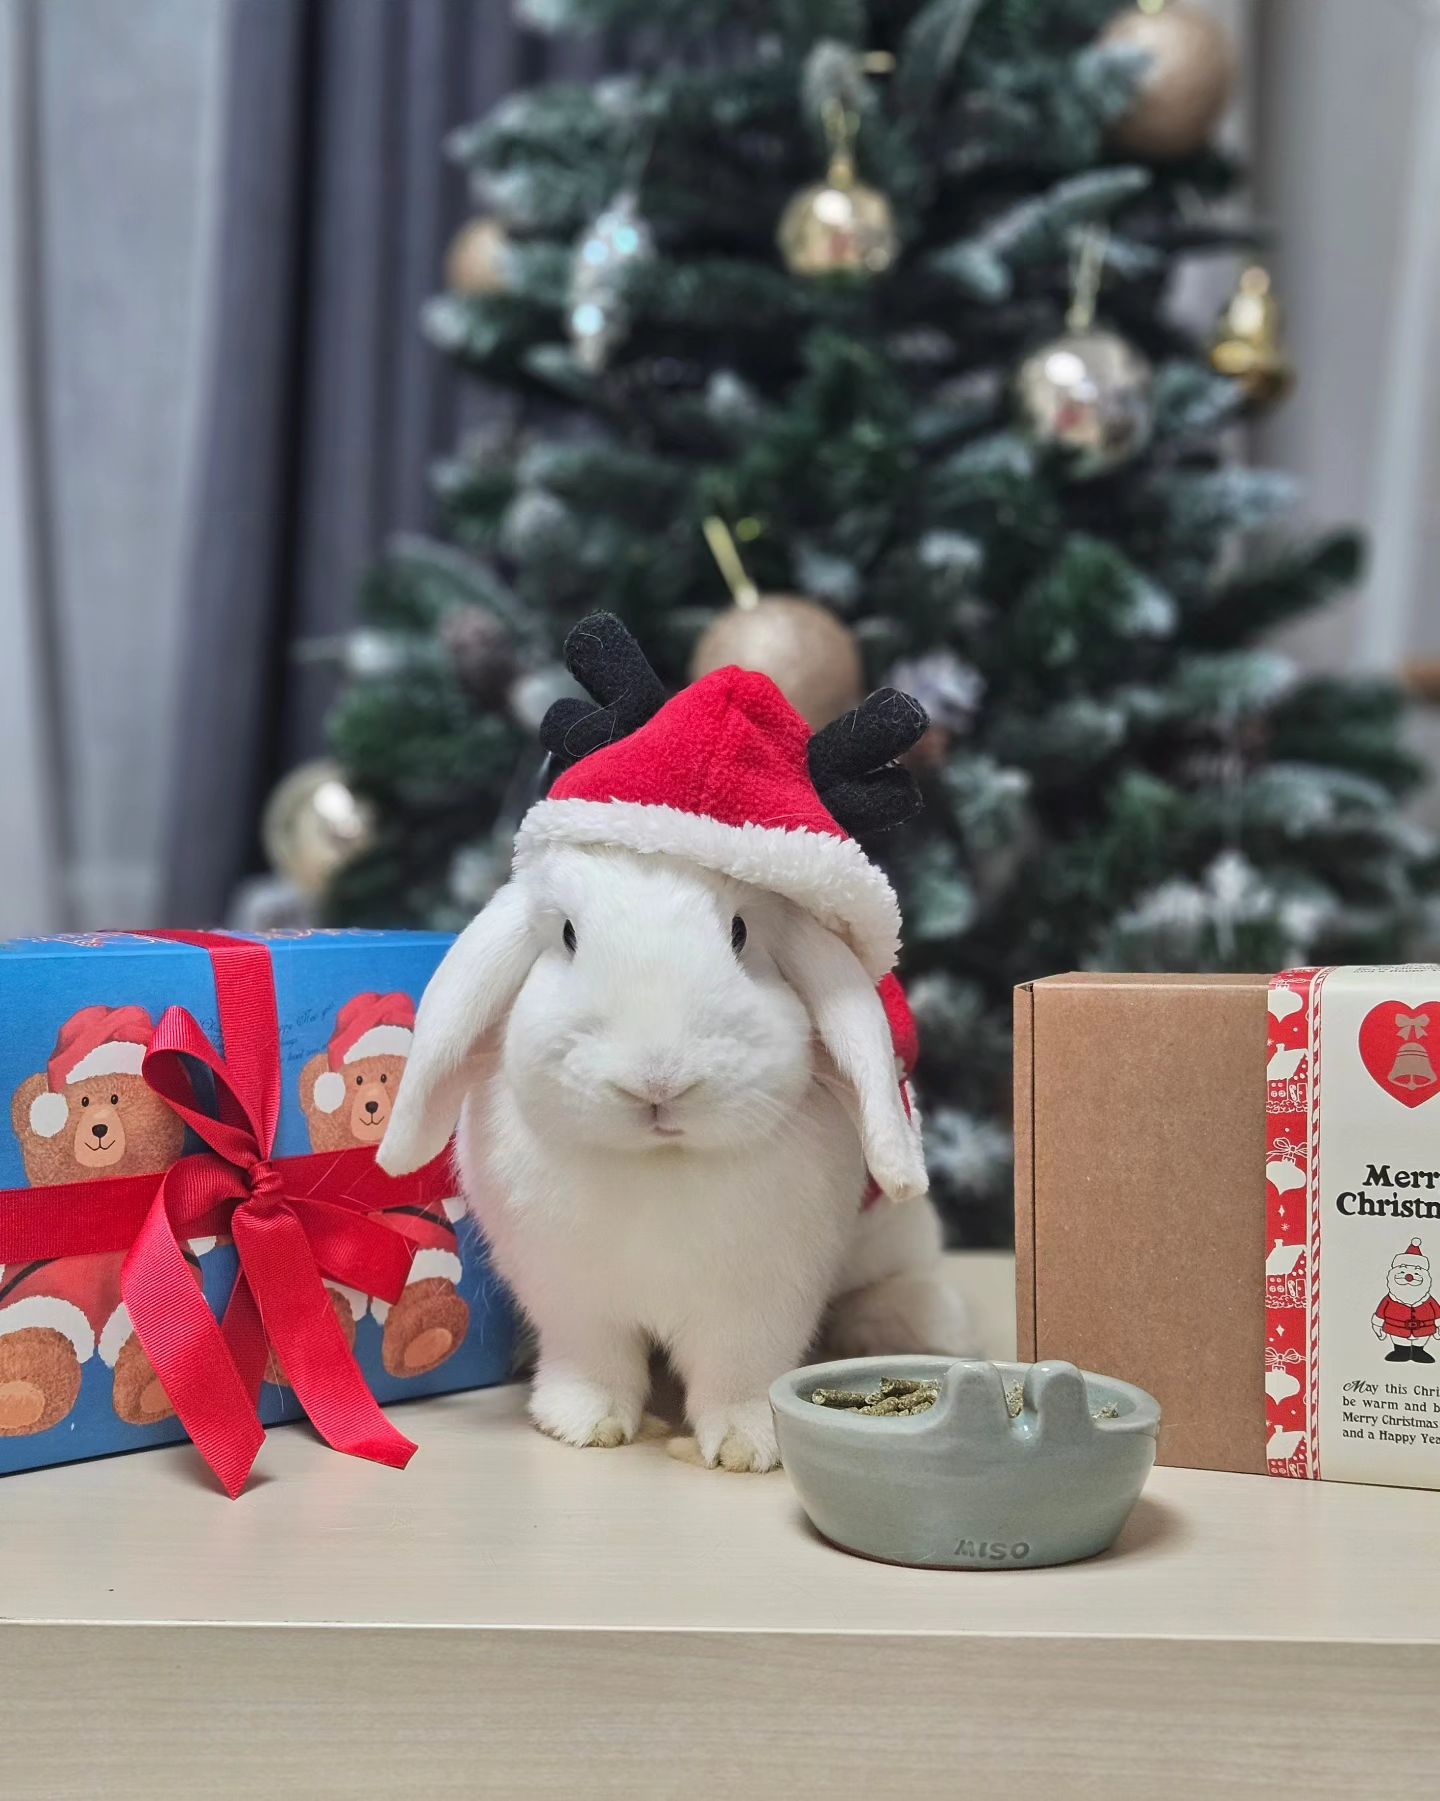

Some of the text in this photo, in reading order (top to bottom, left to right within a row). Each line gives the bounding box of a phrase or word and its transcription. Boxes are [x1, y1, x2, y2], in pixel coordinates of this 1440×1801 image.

[1362, 1164, 1440, 1189] Merr
[1343, 1380, 1440, 1397] May this Chri
[1342, 1396, 1356, 1407] be
[1362, 1400, 1398, 1410] warm
[1404, 1402, 1427, 1412] and
[1342, 1411, 1438, 1428] Merry Christmas
[1342, 1429, 1364, 1439] and
[1368, 1431, 1375, 1439] a
[1379, 1430, 1416, 1445] Happy
[954, 1540, 1030, 1560] MISO
